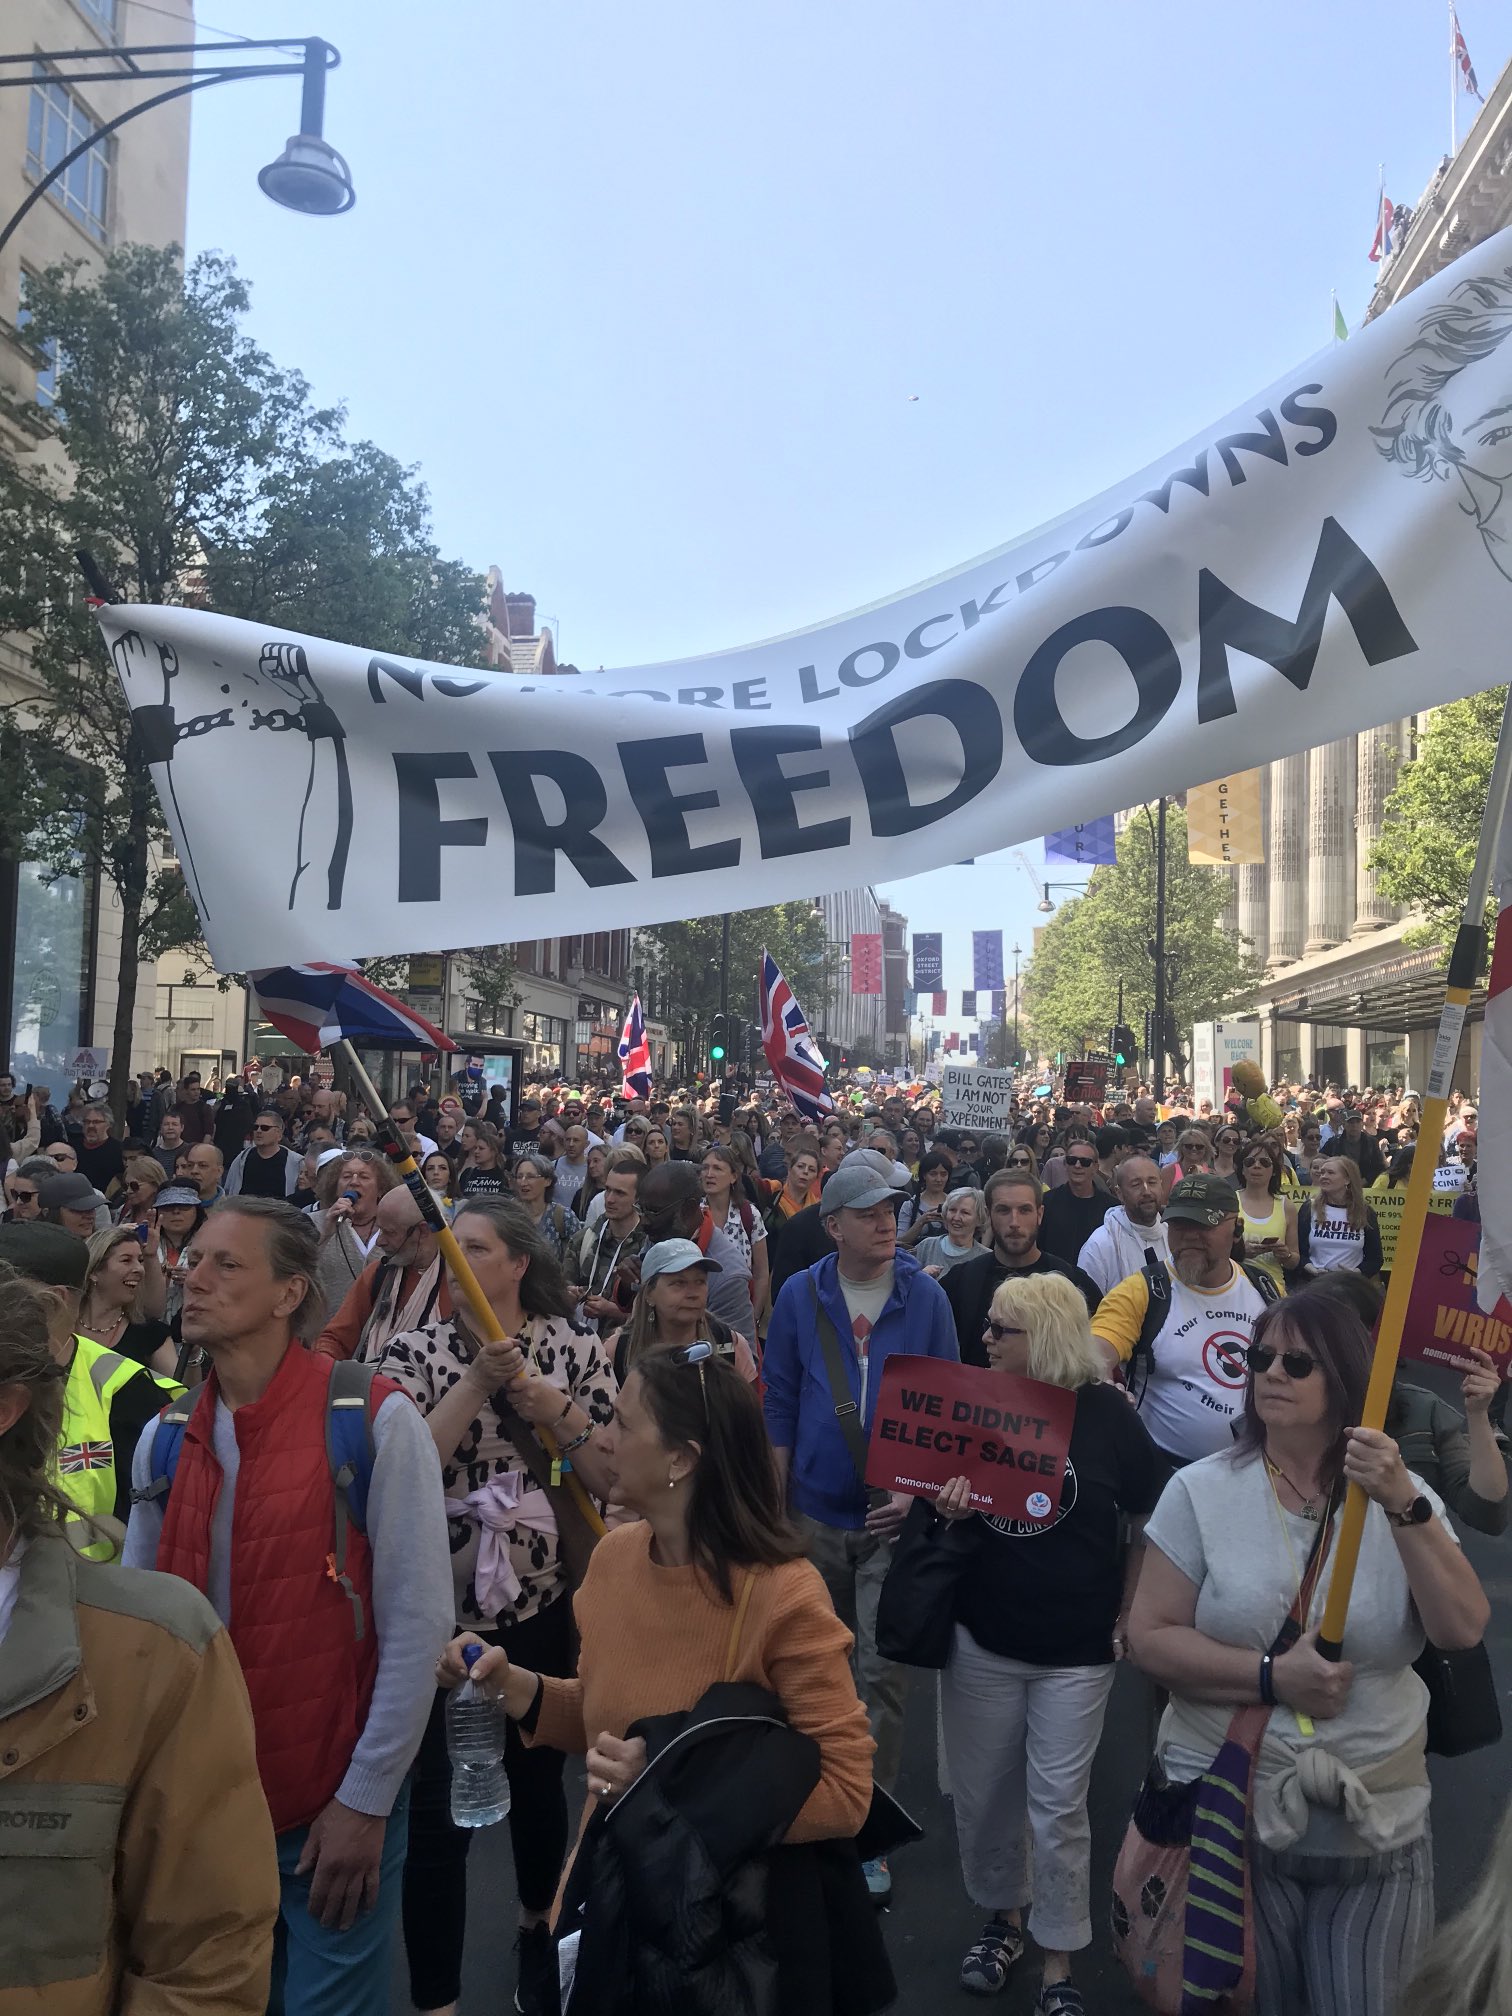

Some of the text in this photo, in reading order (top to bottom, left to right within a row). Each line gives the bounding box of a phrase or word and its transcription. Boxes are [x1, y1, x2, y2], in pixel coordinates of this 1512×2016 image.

[367, 656, 493, 704] NO
[798, 383, 1338, 704] LOCKDOWNS
[391, 515, 1420, 904] FREEDOM
[1218, 783, 1233, 862] GETHER
[1224, 1039, 1253, 1049] WELCOME
[948, 1071, 973, 1086] BILL
[955, 1088, 1008, 1105] I AM NOT
[966, 1103, 994, 1115] YOUR
[1437, 1168, 1452, 1177] TO
[1364, 1195, 1406, 1206] STAND
[1313, 1229, 1361, 1241] MATTERS
[1174, 1317, 1199, 1339] Your
[1433, 1304, 1512, 1355] VIRUS
[901, 1388, 1050, 1440] WE DIDN'T
[1200, 1394, 1235, 1416] their
[879, 1418, 973, 1456] ELECT
[979, 1440, 1058, 1477] SAGE
[0, 1810, 73, 1830] ROTEST
